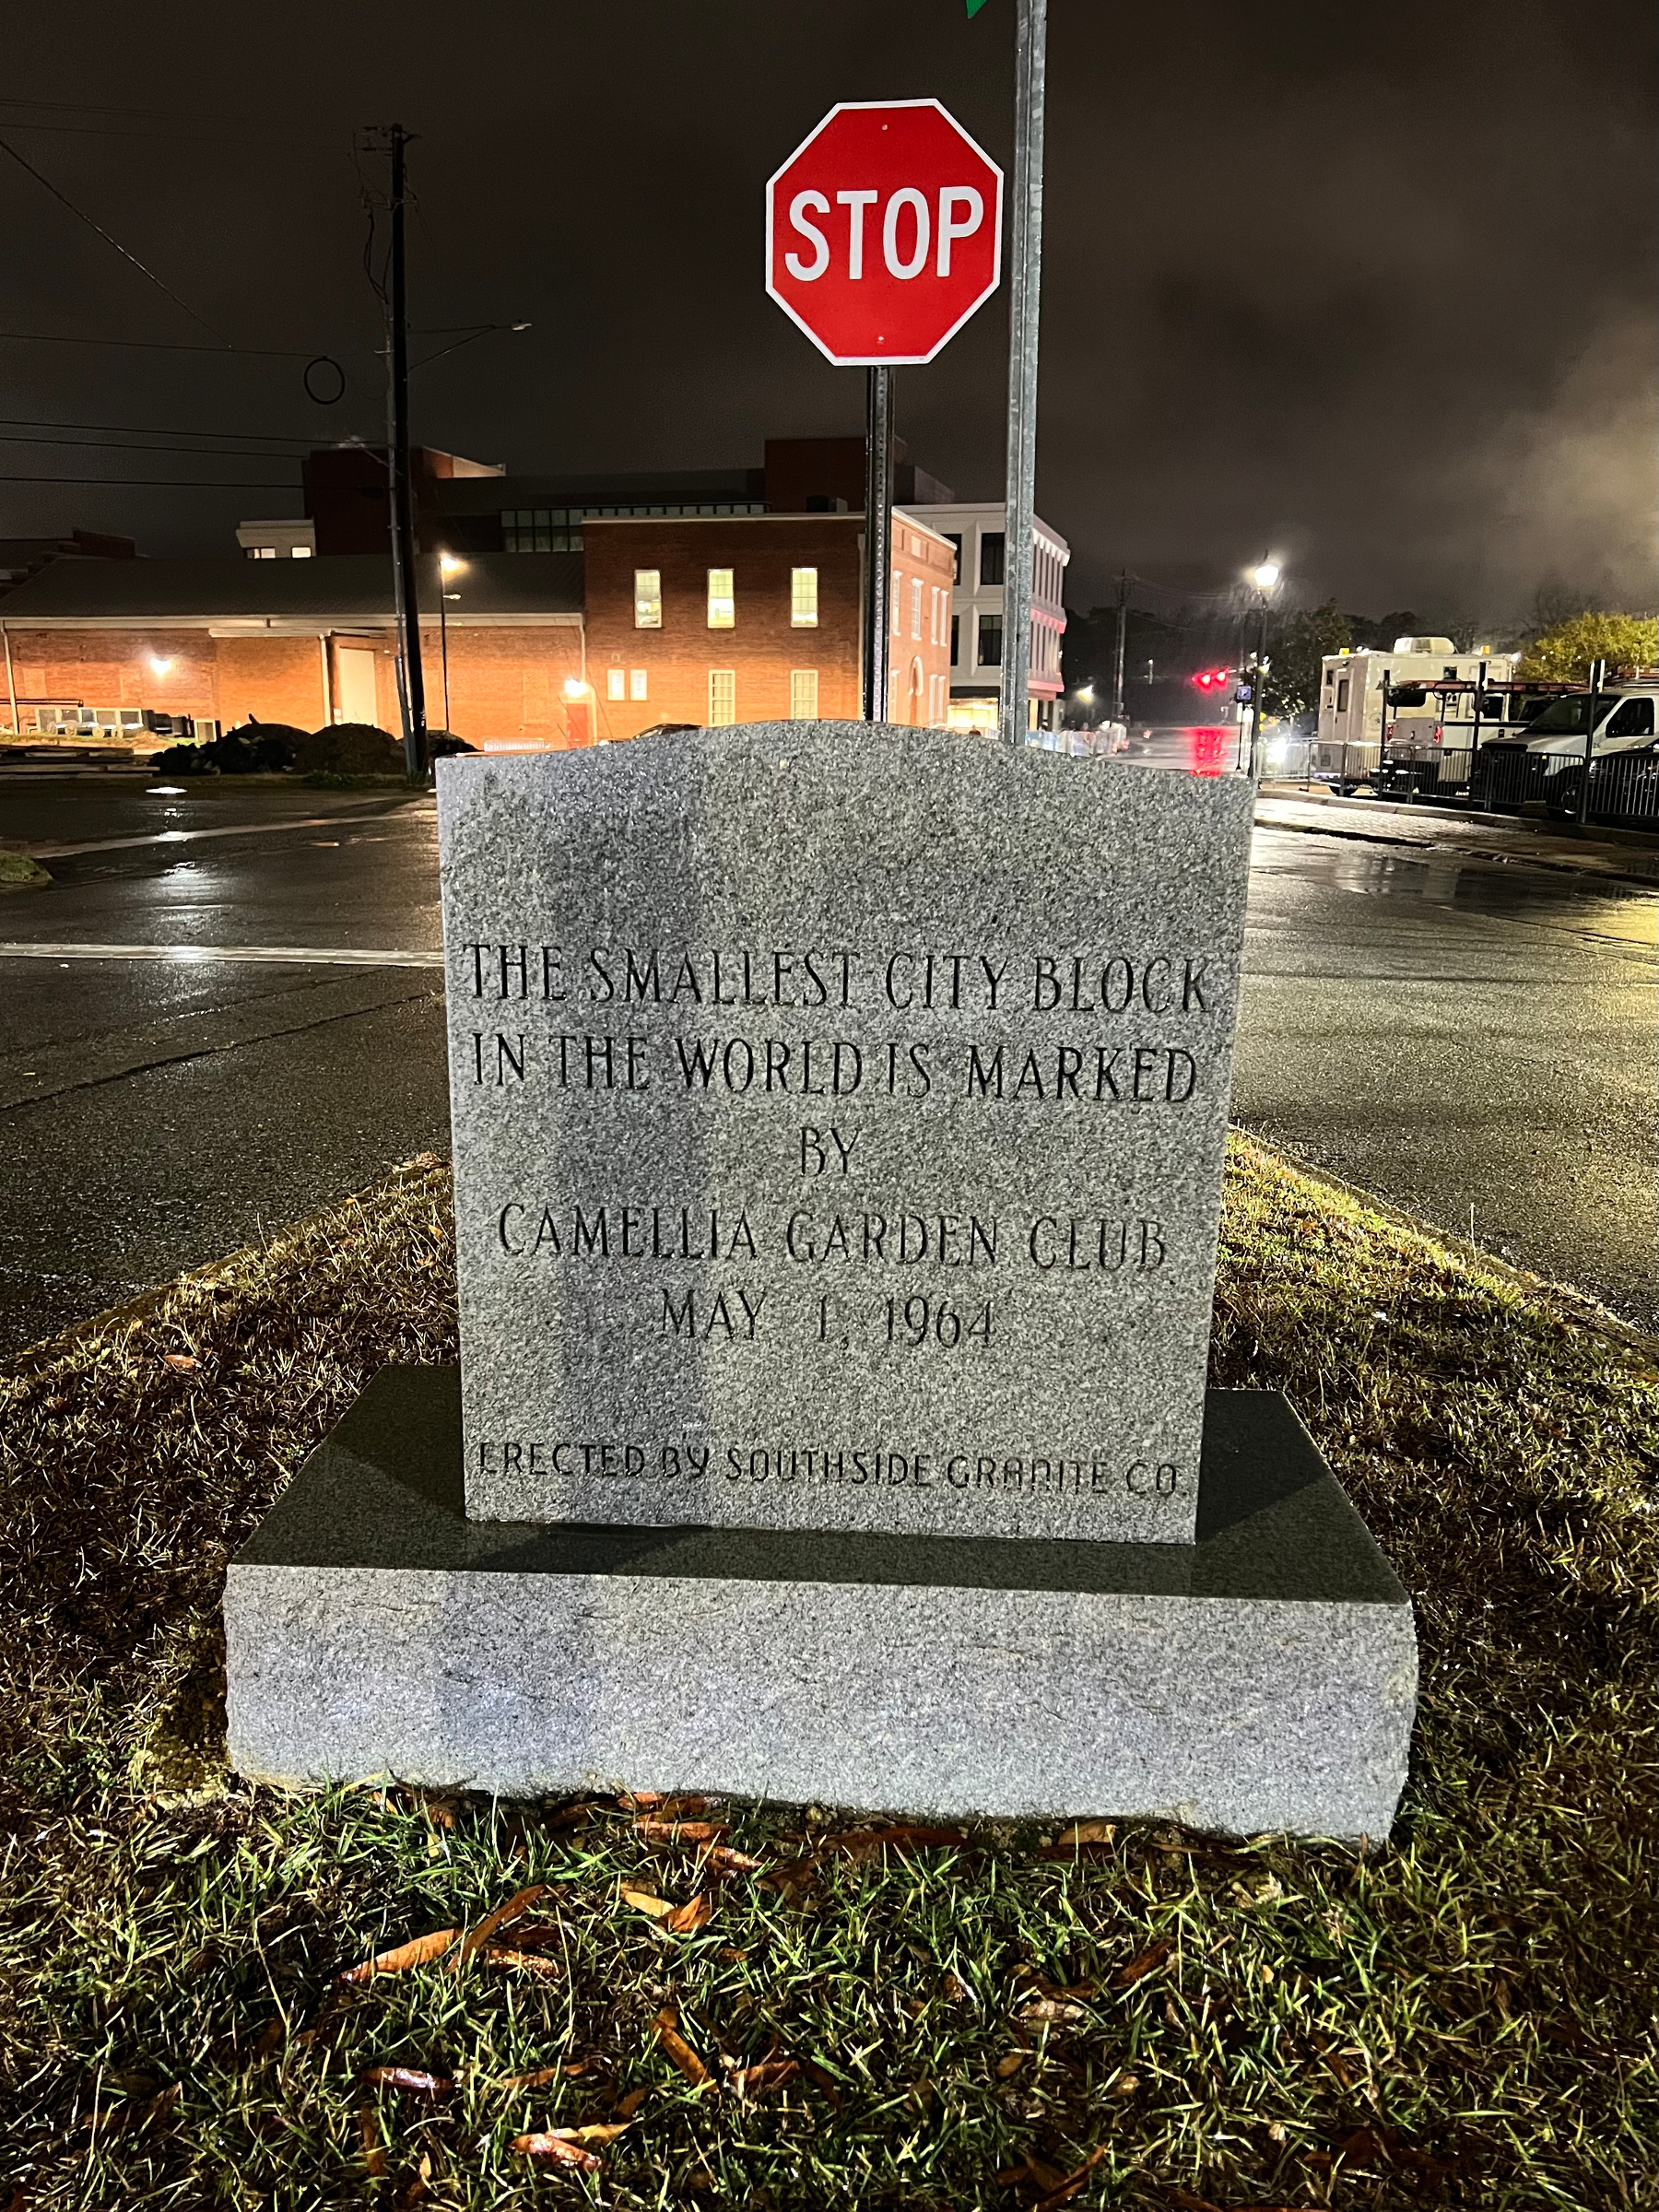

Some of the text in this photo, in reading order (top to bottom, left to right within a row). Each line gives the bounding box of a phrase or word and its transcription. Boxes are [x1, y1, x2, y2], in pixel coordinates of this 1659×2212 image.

[785, 186, 983, 281] STOP
[463, 943, 1209, 1014] THE SMALLEST CITY BLOCK
[471, 1032, 1197, 1103] IN THE WORLD IS MARKED
[799, 1126, 861, 1177] BY
[499, 1203, 1166, 1272] CAMELLIA GARDEN CLUB
[661, 1288, 768, 1340] MAY
[885, 1295, 996, 1349] 1964
[478, 1442, 645, 1477] ERECTED
[662, 1446, 710, 1479] BY
[726, 1447, 931, 1487] SOUTHSIDE
